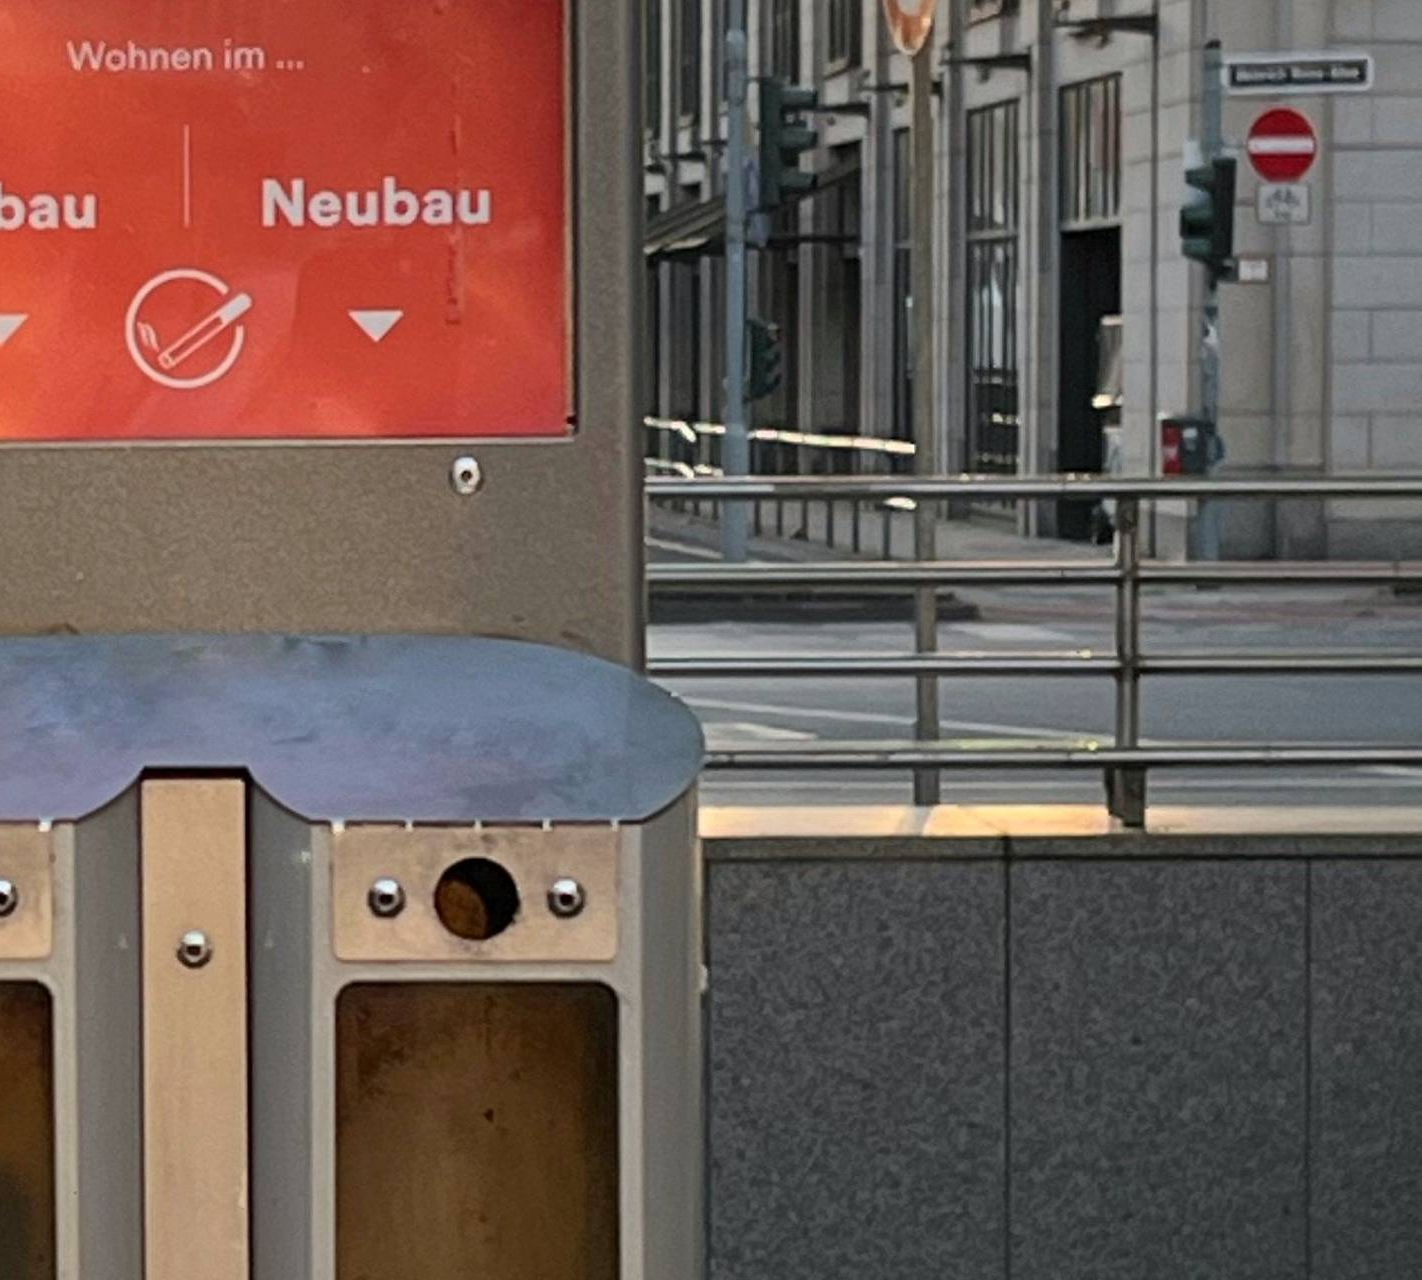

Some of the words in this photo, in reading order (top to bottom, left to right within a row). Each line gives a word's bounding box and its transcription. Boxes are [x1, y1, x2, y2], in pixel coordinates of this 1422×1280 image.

[67, 40, 213, 71] Wohnen
[223, 39, 266, 70] im
[261, 176, 492, 227] Neubau
